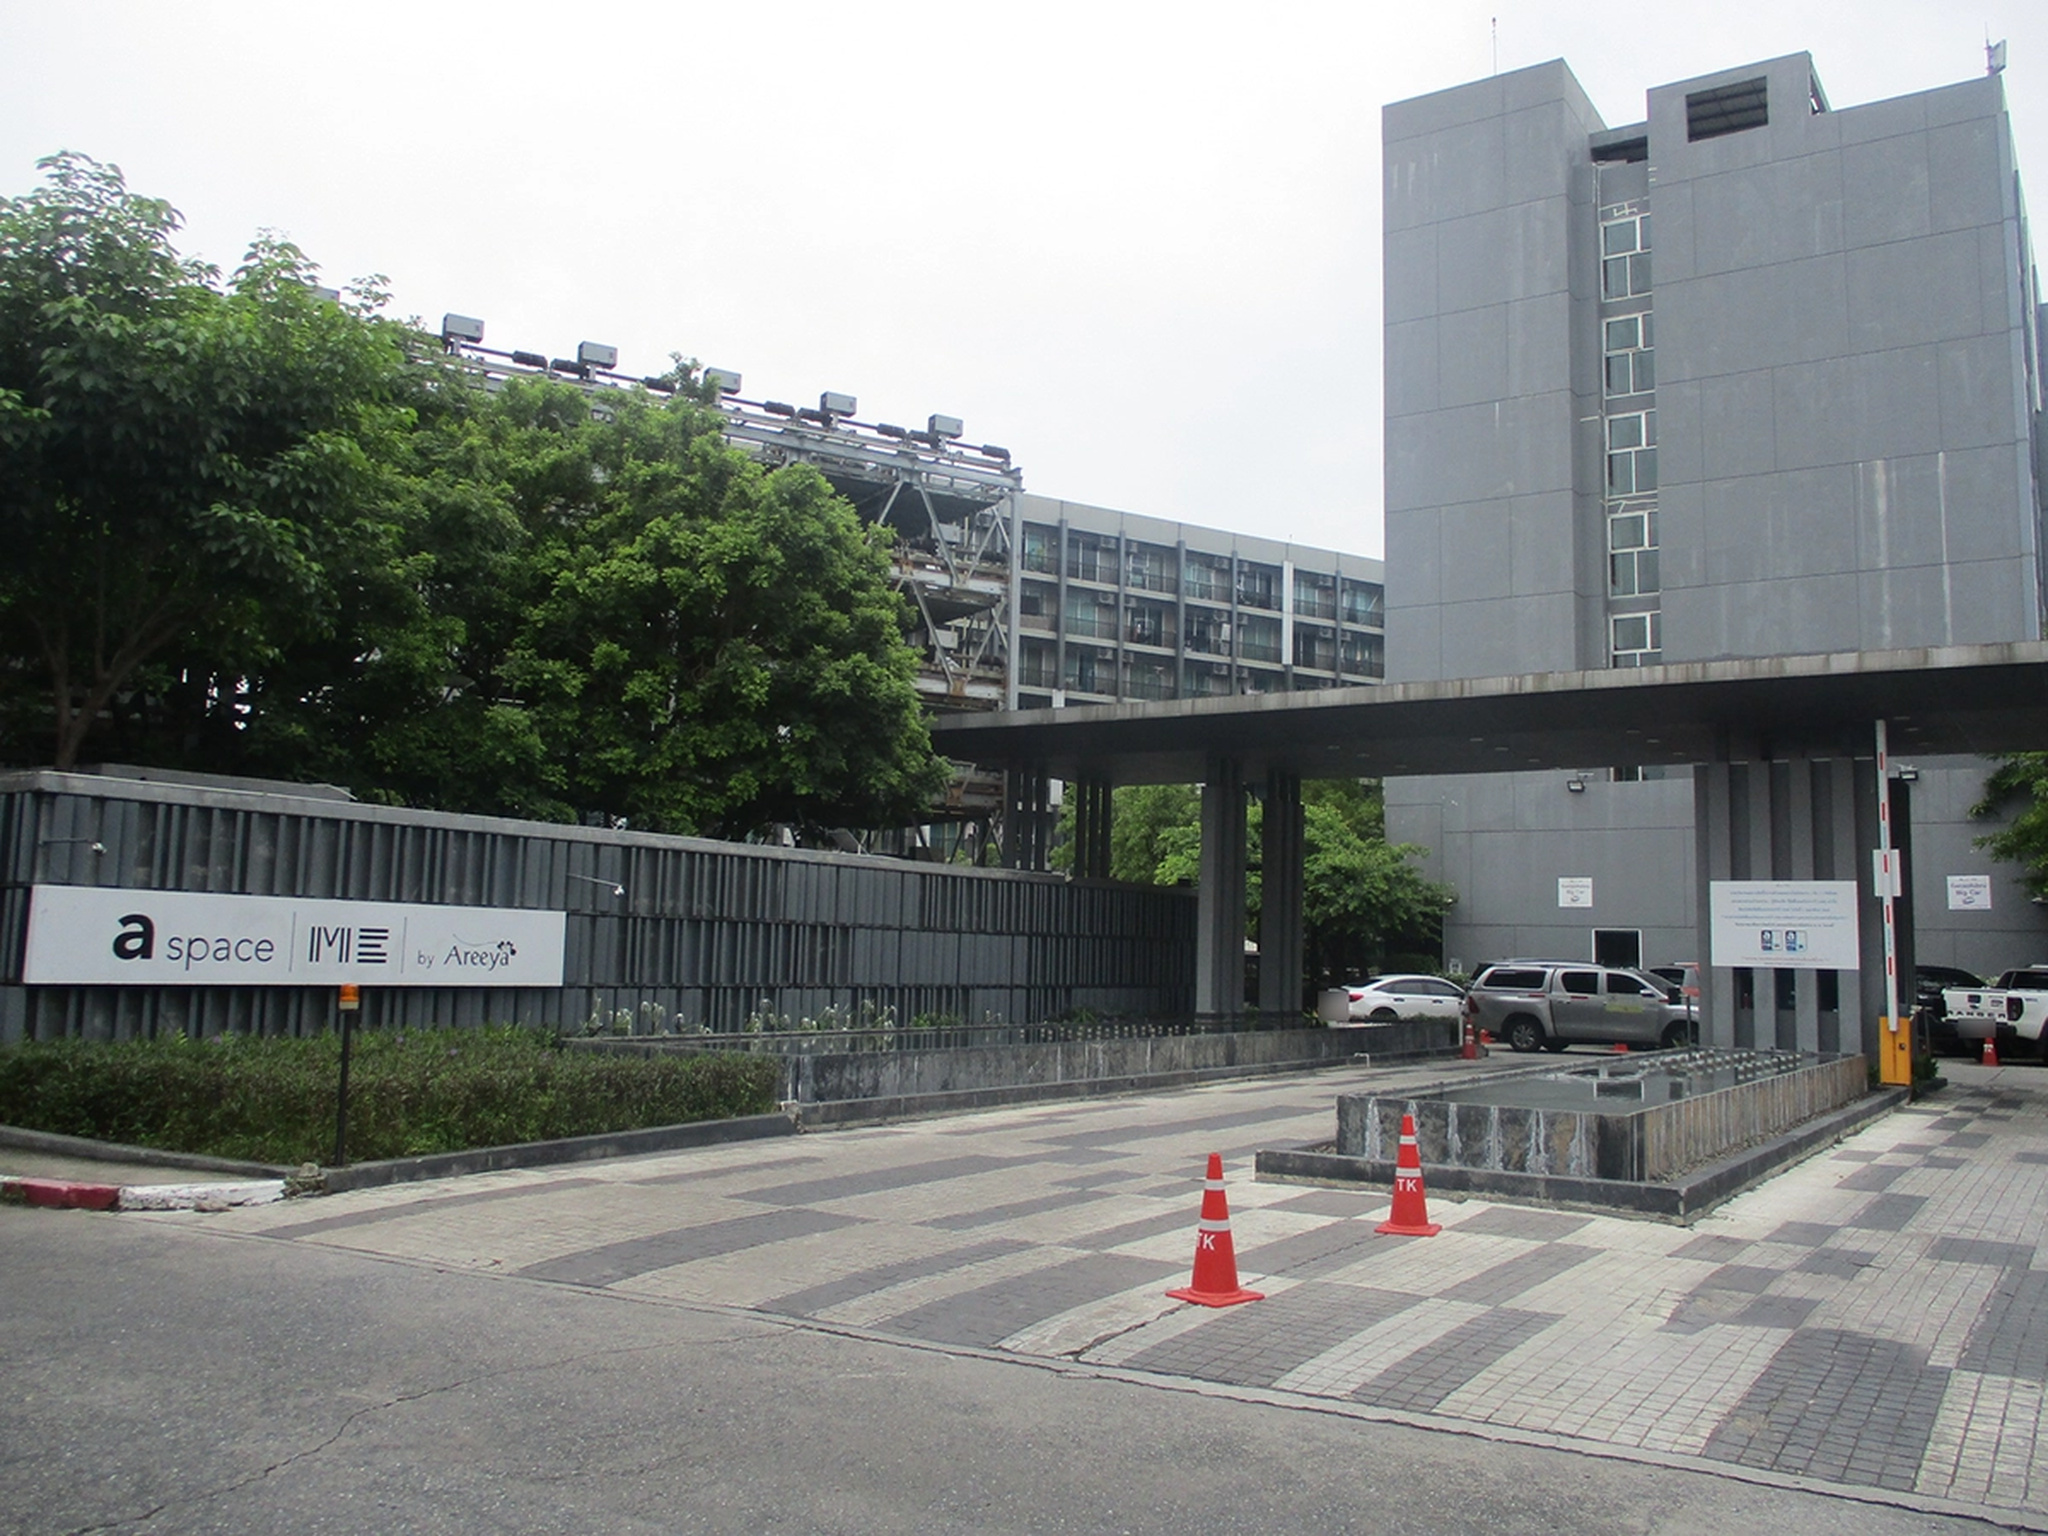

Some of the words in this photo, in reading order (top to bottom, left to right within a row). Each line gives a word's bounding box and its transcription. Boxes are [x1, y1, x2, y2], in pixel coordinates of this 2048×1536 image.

[112, 914, 154, 960] a
[166, 936, 274, 971] space
[417, 950, 435, 968] by
[443, 944, 510, 972] Areeya
[1396, 1178, 1418, 1193] TK
